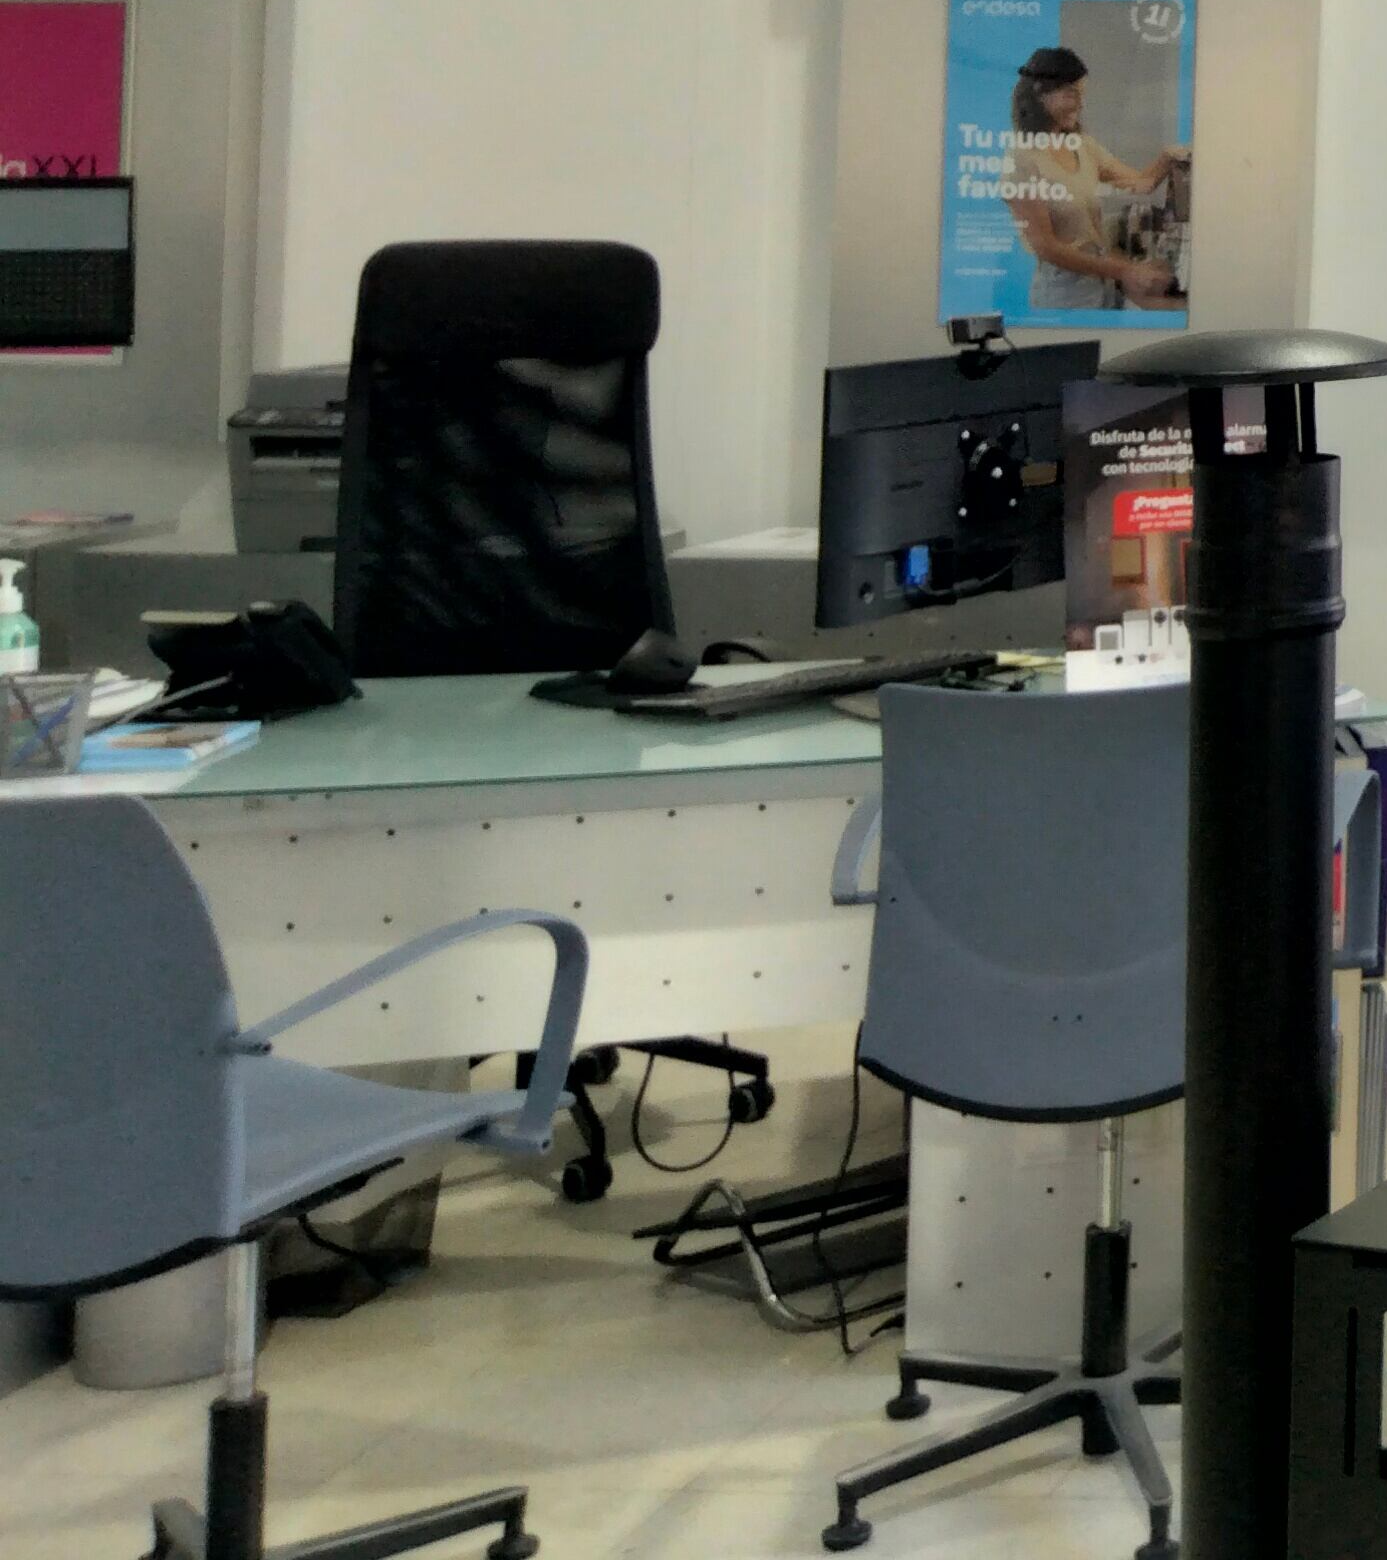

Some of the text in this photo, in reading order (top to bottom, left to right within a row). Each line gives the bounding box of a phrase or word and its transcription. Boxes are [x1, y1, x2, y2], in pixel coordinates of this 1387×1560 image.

[959, 123, 1082, 151] Tu nuevo
[958, 155, 1017, 174] mes
[957, 174, 1075, 201] favorito.
[1089, 429, 1145, 447] Disfruta
[1147, 427, 1166, 442] de
[1167, 426, 1181, 441] la
[1118, 446, 1137, 459] de
[1102, 462, 1127, 476] con
